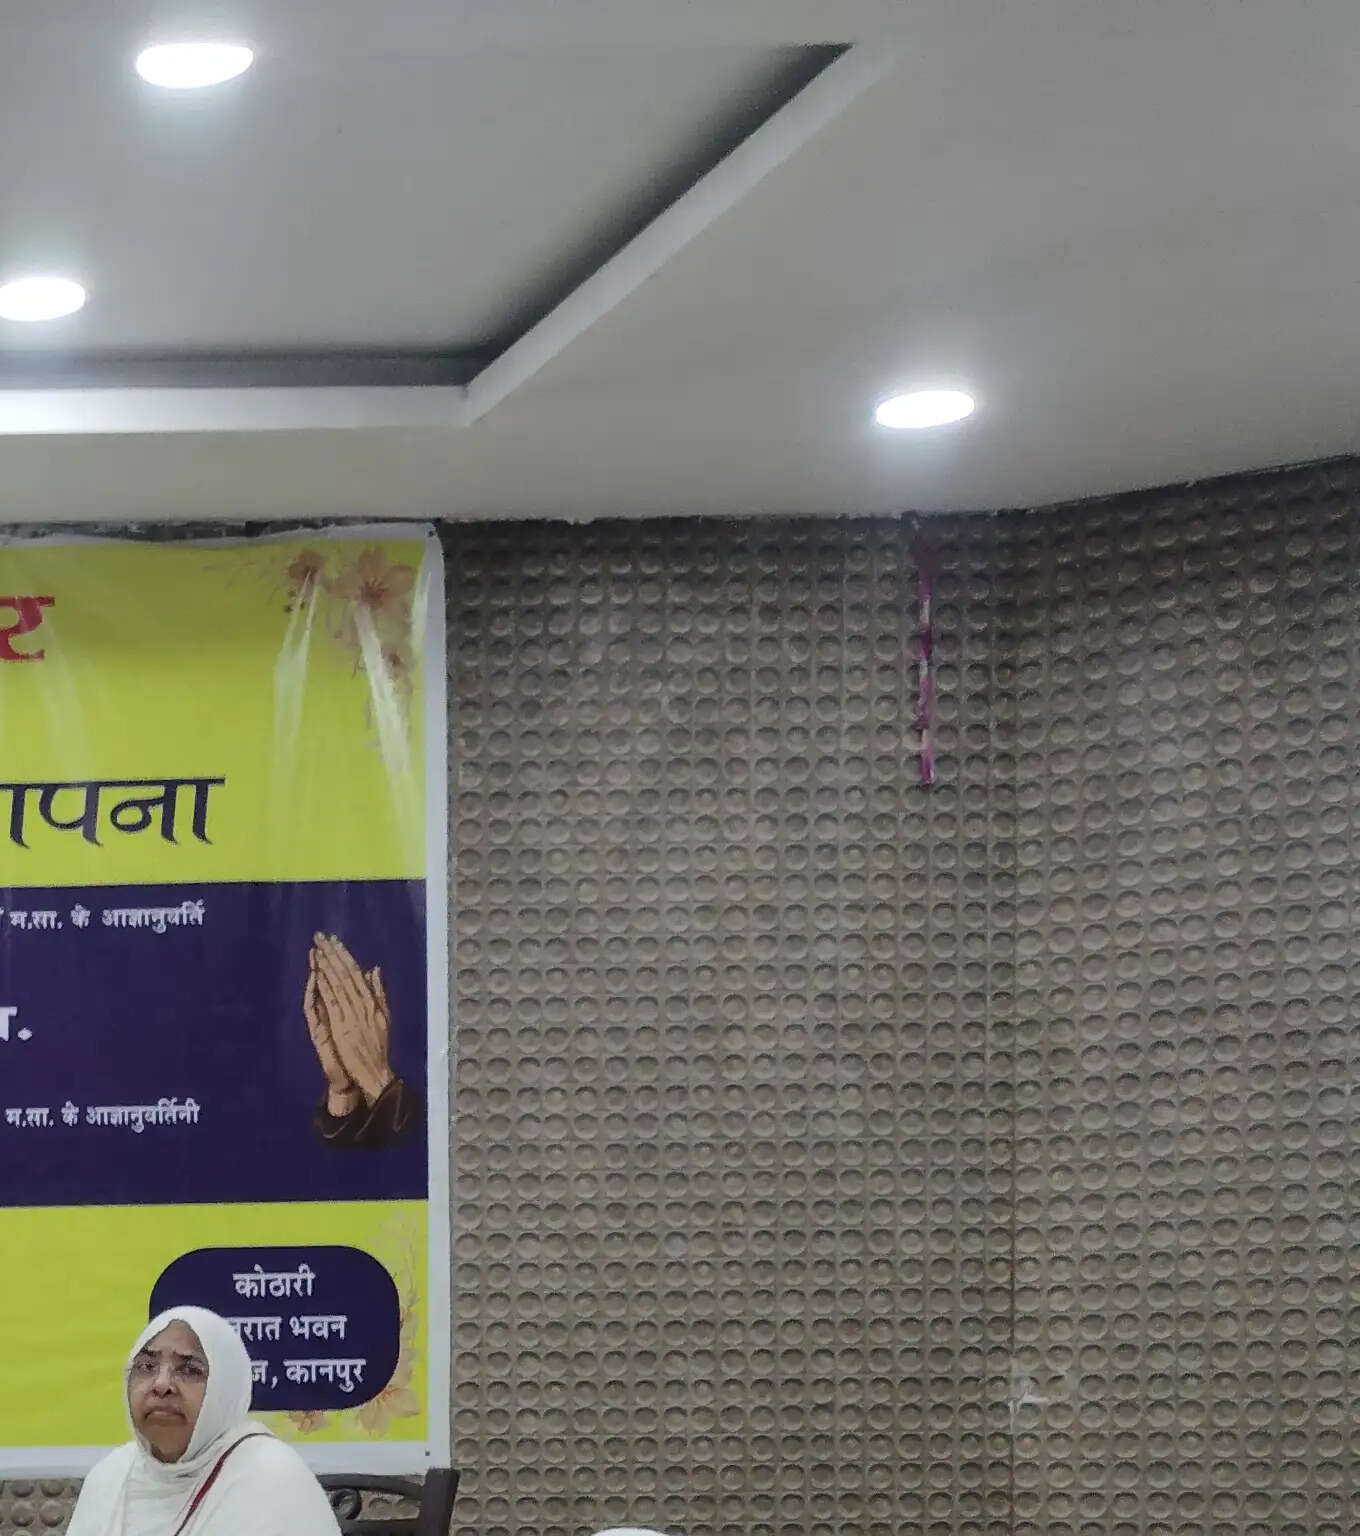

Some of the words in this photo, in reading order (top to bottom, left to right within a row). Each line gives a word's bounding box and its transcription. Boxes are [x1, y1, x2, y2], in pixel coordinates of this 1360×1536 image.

[70, 903, 91, 928] के
[60, 1100, 80, 1127] के
[232, 1262, 316, 1299] कोठारी
[224, 1316, 283, 1342] रात
[288, 1315, 348, 1341] भवन
[283, 1358, 367, 1393] कानपुर
